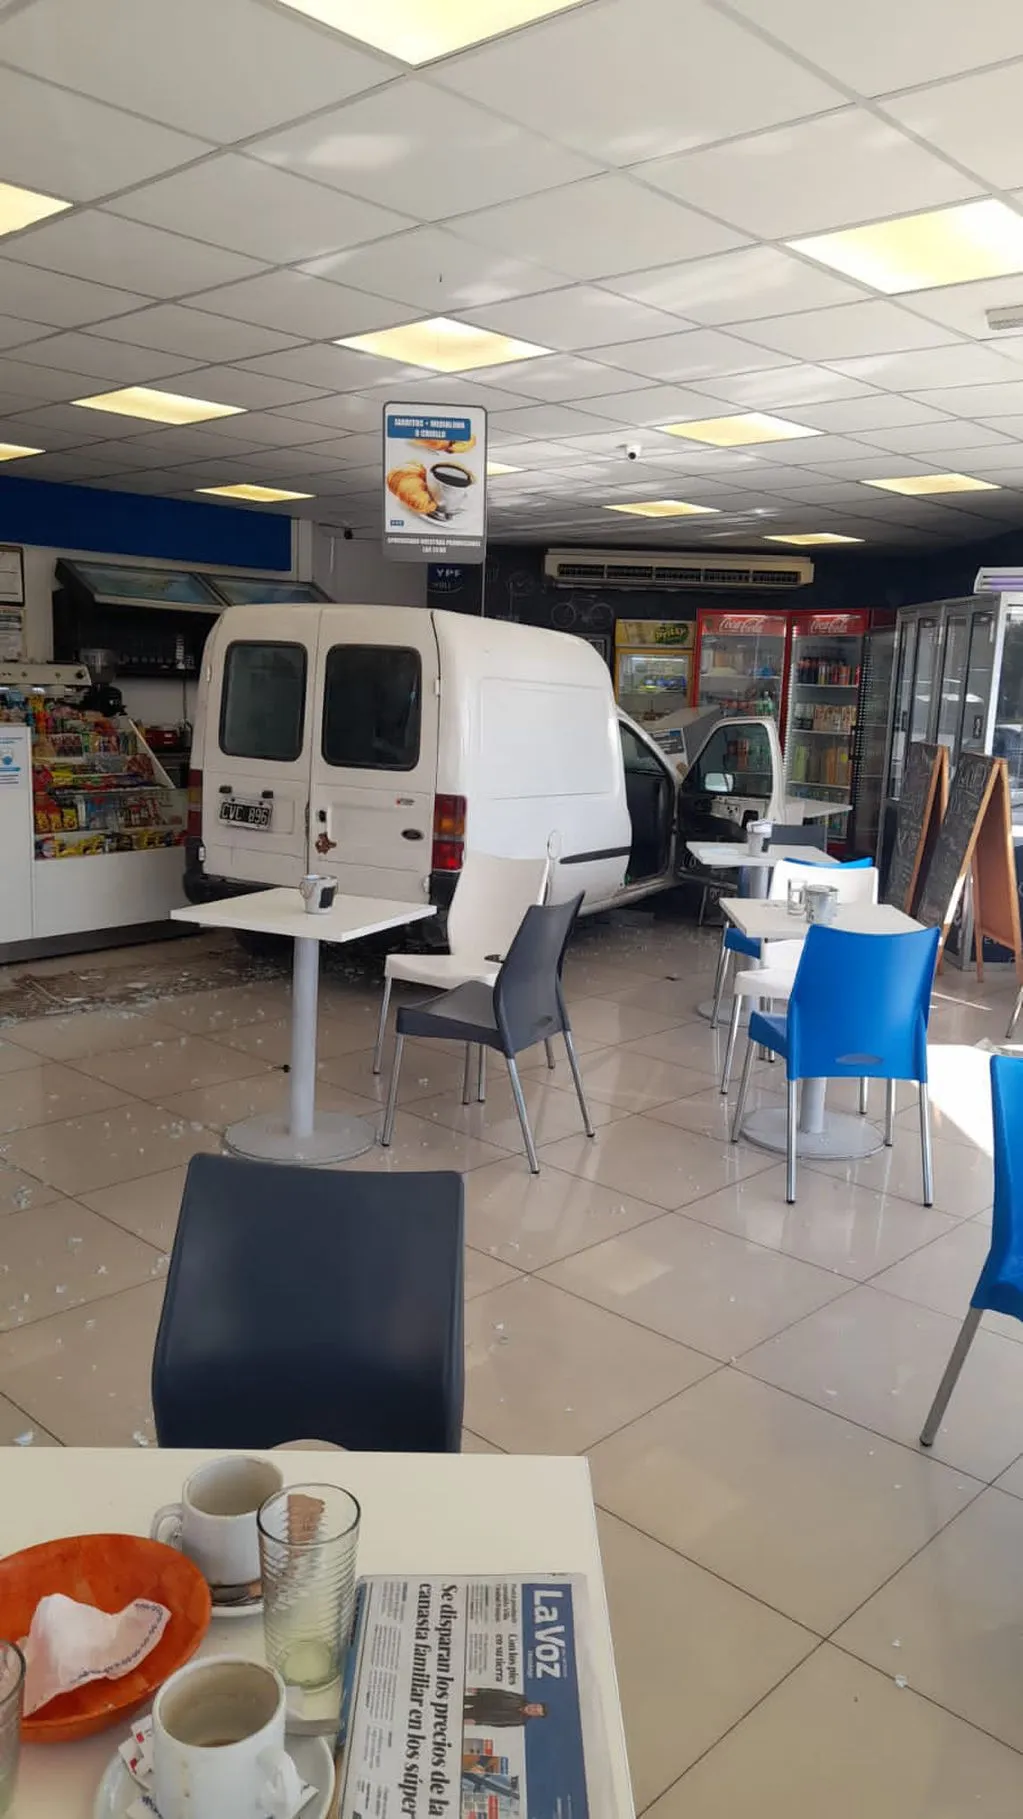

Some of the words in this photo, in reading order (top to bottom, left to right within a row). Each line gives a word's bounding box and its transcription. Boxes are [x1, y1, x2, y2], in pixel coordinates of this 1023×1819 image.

[718, 616, 766, 634] Coca-Cola
[810, 616, 849, 634] Coca-Cola
[221, 803, 243, 821] CVC
[247, 807, 269, 825] 896
[441, 1584, 458, 1602] Se
[415, 1583, 432, 1640] canasta
[534, 1590, 563, 1624] La
[434, 1604, 458, 1673] disparan
[410, 1643, 432, 1707] familiar
[435, 1675, 455, 1699] los
[408, 1708, 422, 1730] en
[406, 1732, 426, 1760] los
[430, 1701, 452, 1768] precios
[398, 1762, 423, 1819] súper
[430, 1771, 450, 1795] de
[428, 1798, 450, 1816] la
